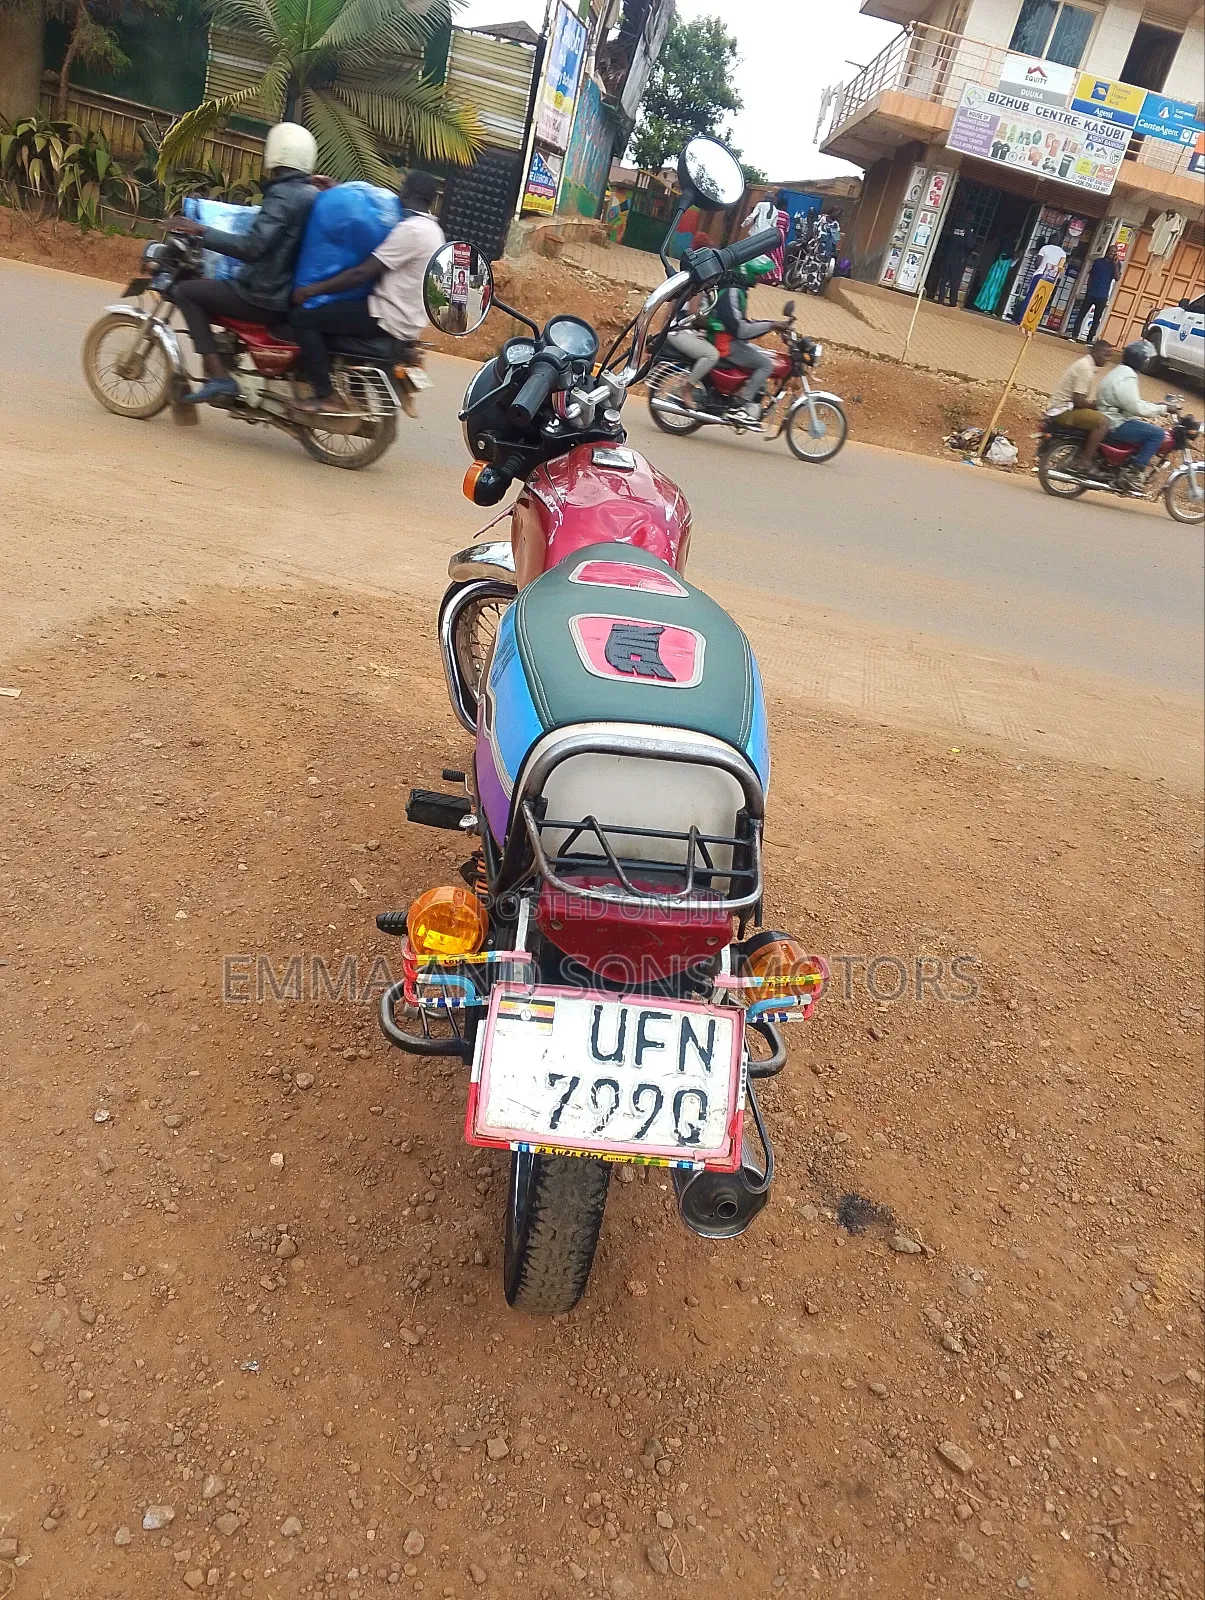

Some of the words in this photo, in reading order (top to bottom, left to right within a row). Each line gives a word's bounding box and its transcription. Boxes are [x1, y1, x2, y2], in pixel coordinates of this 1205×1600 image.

[1024, 75, 1048, 85] EQUITY
[1020, 88, 1044, 100] DUUKA
[968, 111, 983, 119] HOUSE
[987, 91, 1031, 112] BIZHUB
[1083, 119, 1125, 141] KASUBI
[1093, 107, 1114, 119] Agent
[1138, 119, 1179, 136] CenteAgent
[1089, 134, 1104, 144] AGENT
[1104, 137, 1125, 151] BANKING
[1029, 293, 1044, 315] 20
[591, 1003, 717, 1076] UFN
